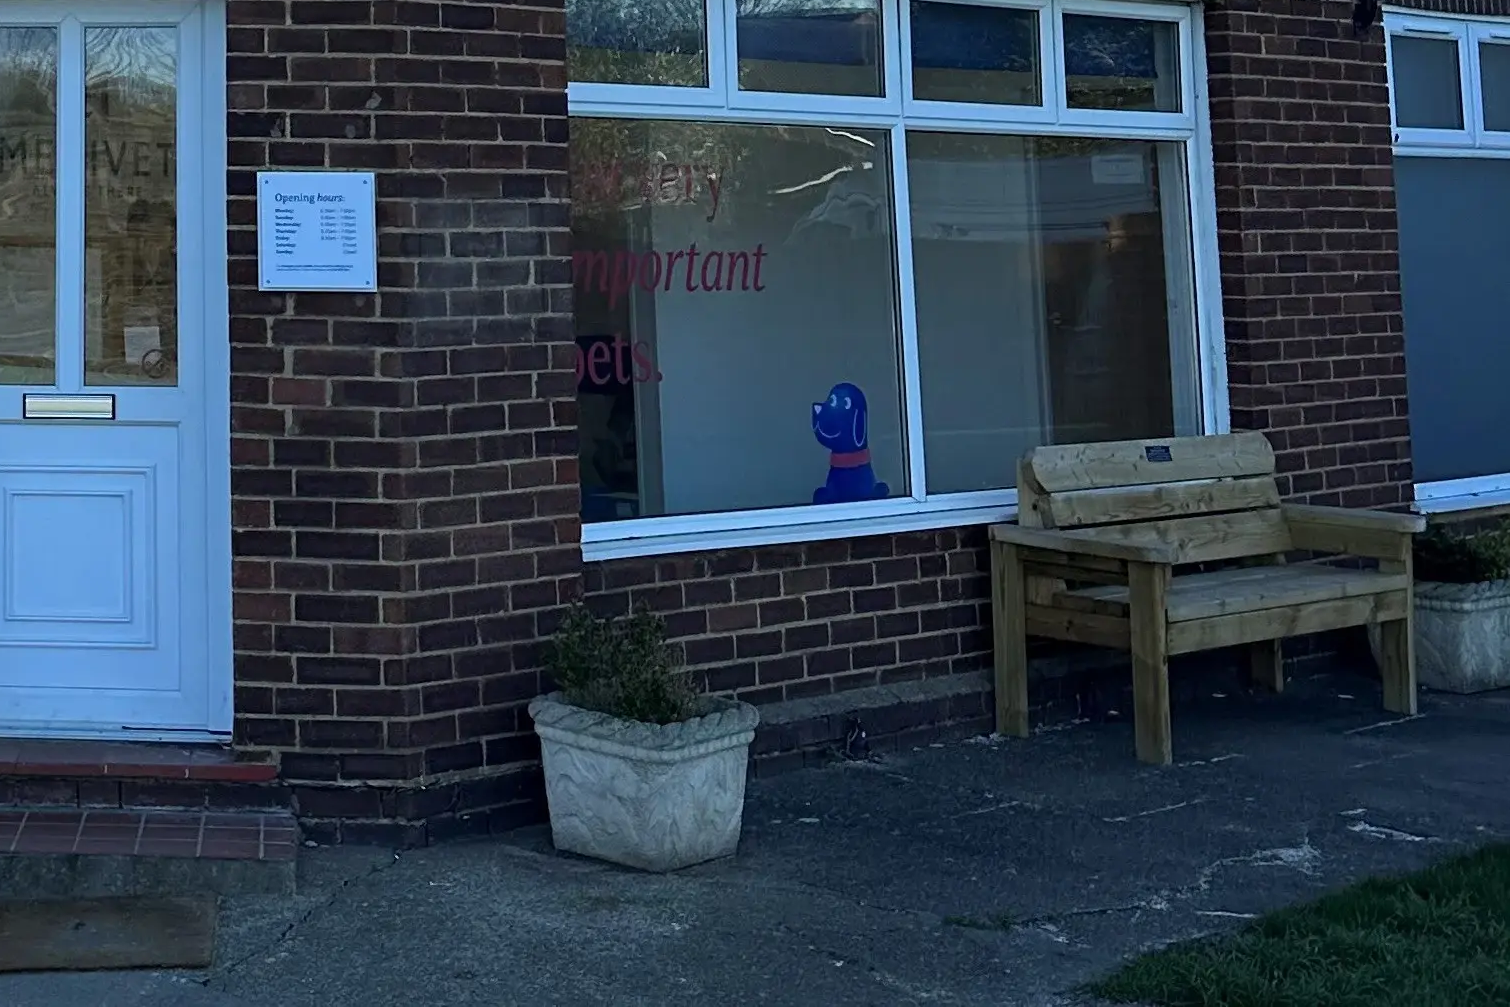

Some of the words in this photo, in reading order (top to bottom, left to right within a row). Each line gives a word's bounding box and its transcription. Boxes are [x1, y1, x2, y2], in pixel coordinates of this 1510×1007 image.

[274, 192, 315, 205] Opening
[638, 162, 727, 223] ery
[573, 241, 768, 311] mportant
